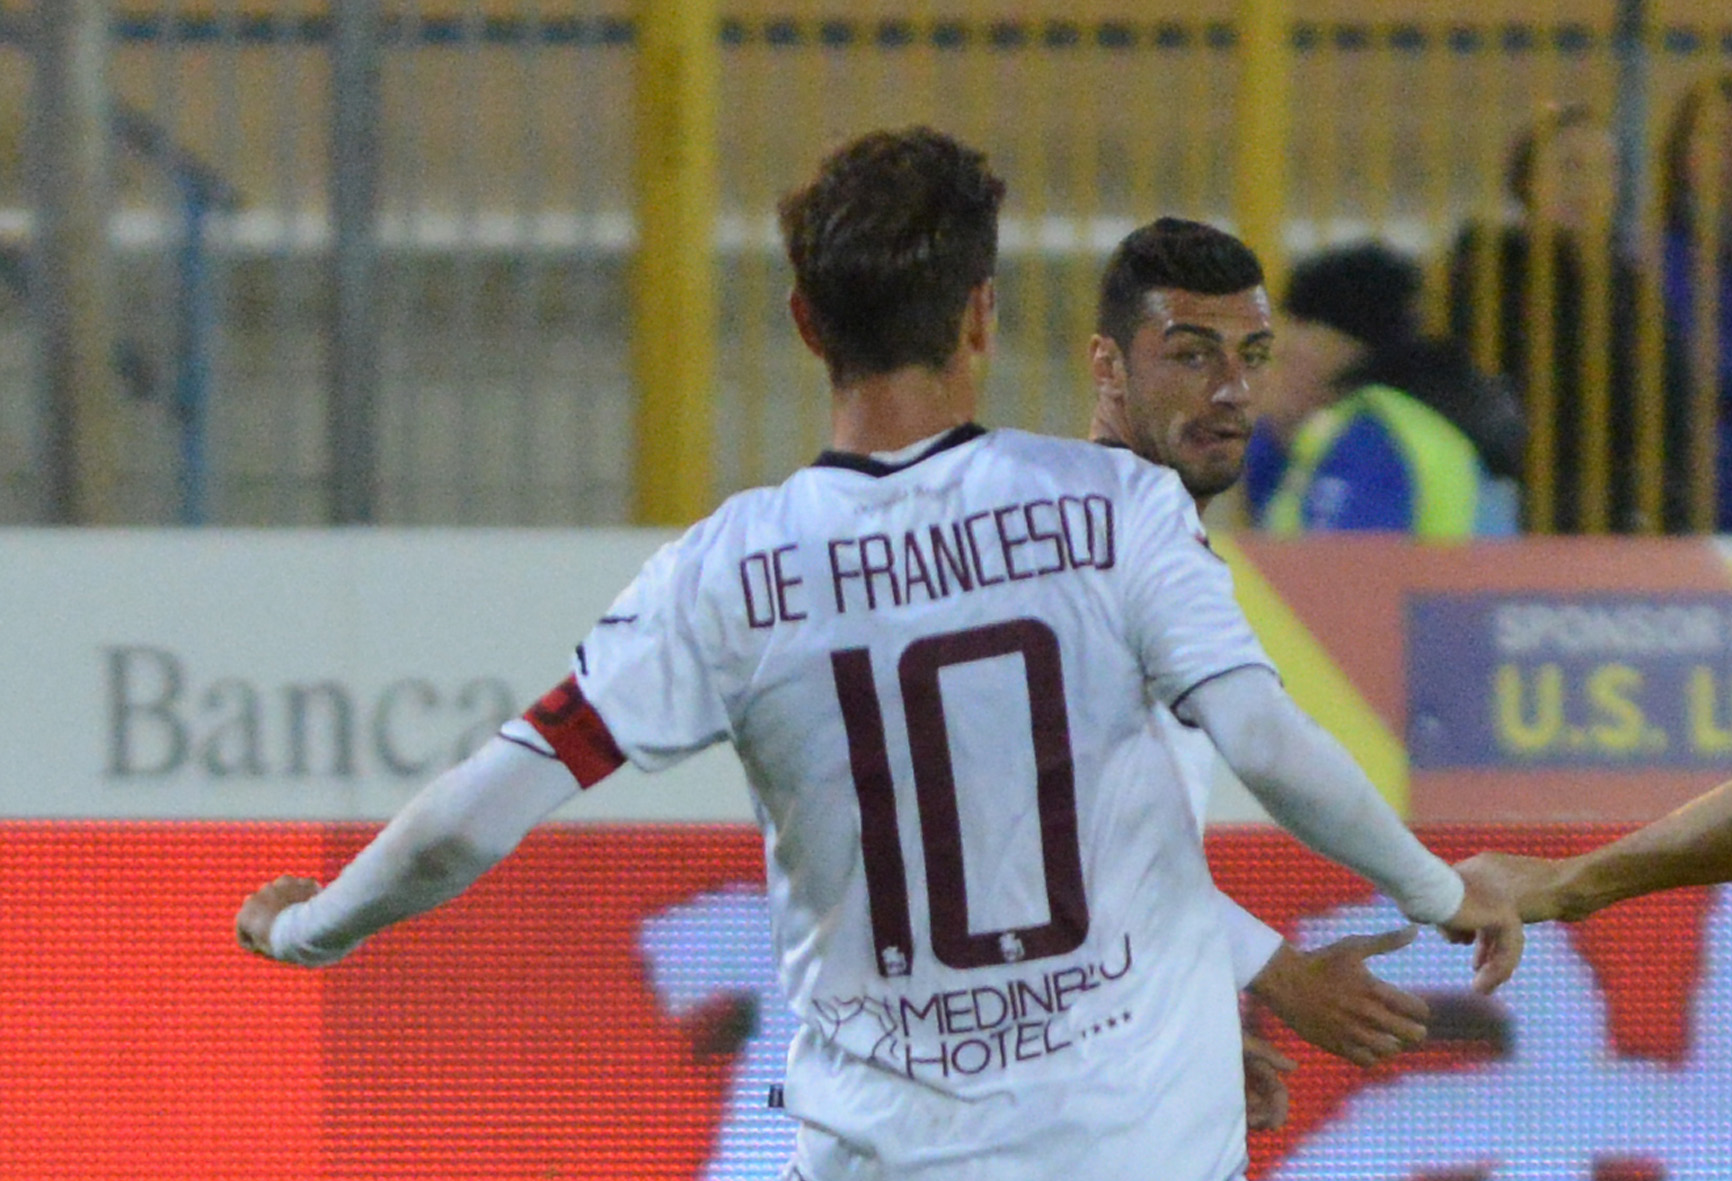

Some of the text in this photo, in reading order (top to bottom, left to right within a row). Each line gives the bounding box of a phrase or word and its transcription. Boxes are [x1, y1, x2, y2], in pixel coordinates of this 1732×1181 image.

[739, 495, 1116, 629] DE FRANCESCO
[1494, 662, 1668, 752] U.S.
[831, 616, 1090, 977] 10
[905, 1021, 1072, 1080] HOTEL
